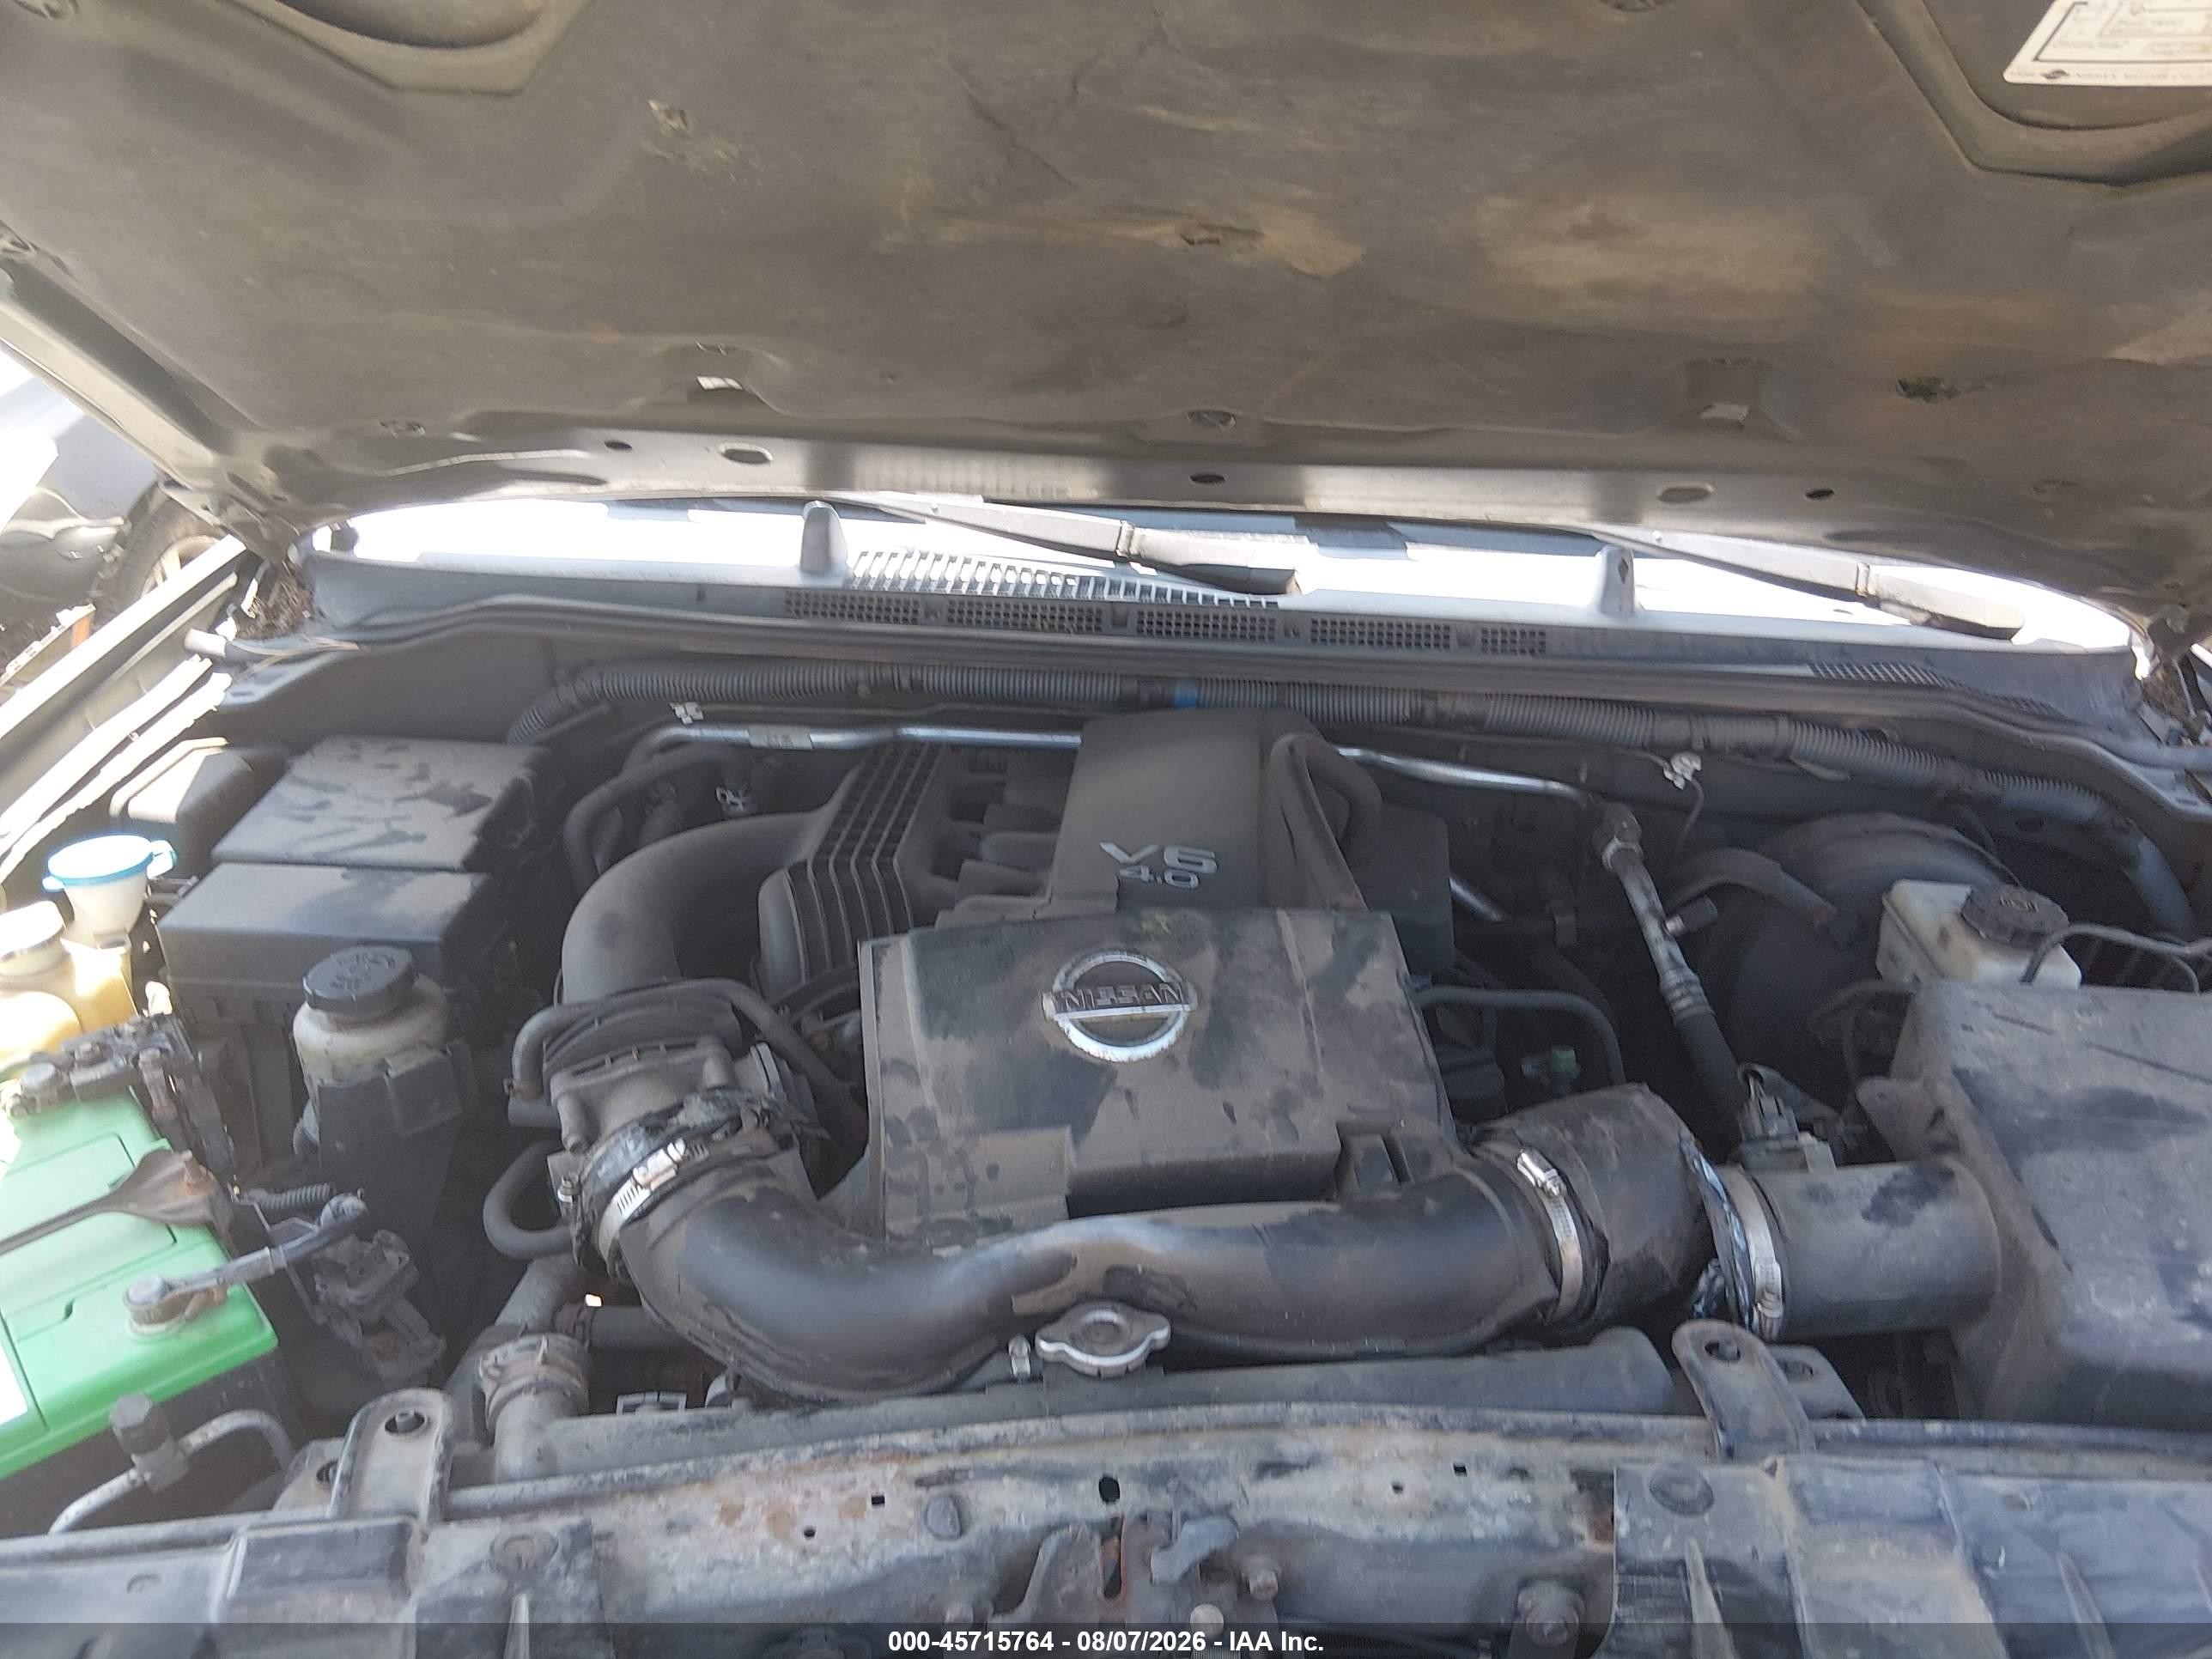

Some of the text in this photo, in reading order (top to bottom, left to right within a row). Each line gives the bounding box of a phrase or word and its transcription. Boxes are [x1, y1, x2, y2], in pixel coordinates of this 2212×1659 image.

[1099, 842, 1218, 874] V6
[1119, 865, 1200, 889] 4.0
[1061, 983, 1185, 1011] NISSAN
